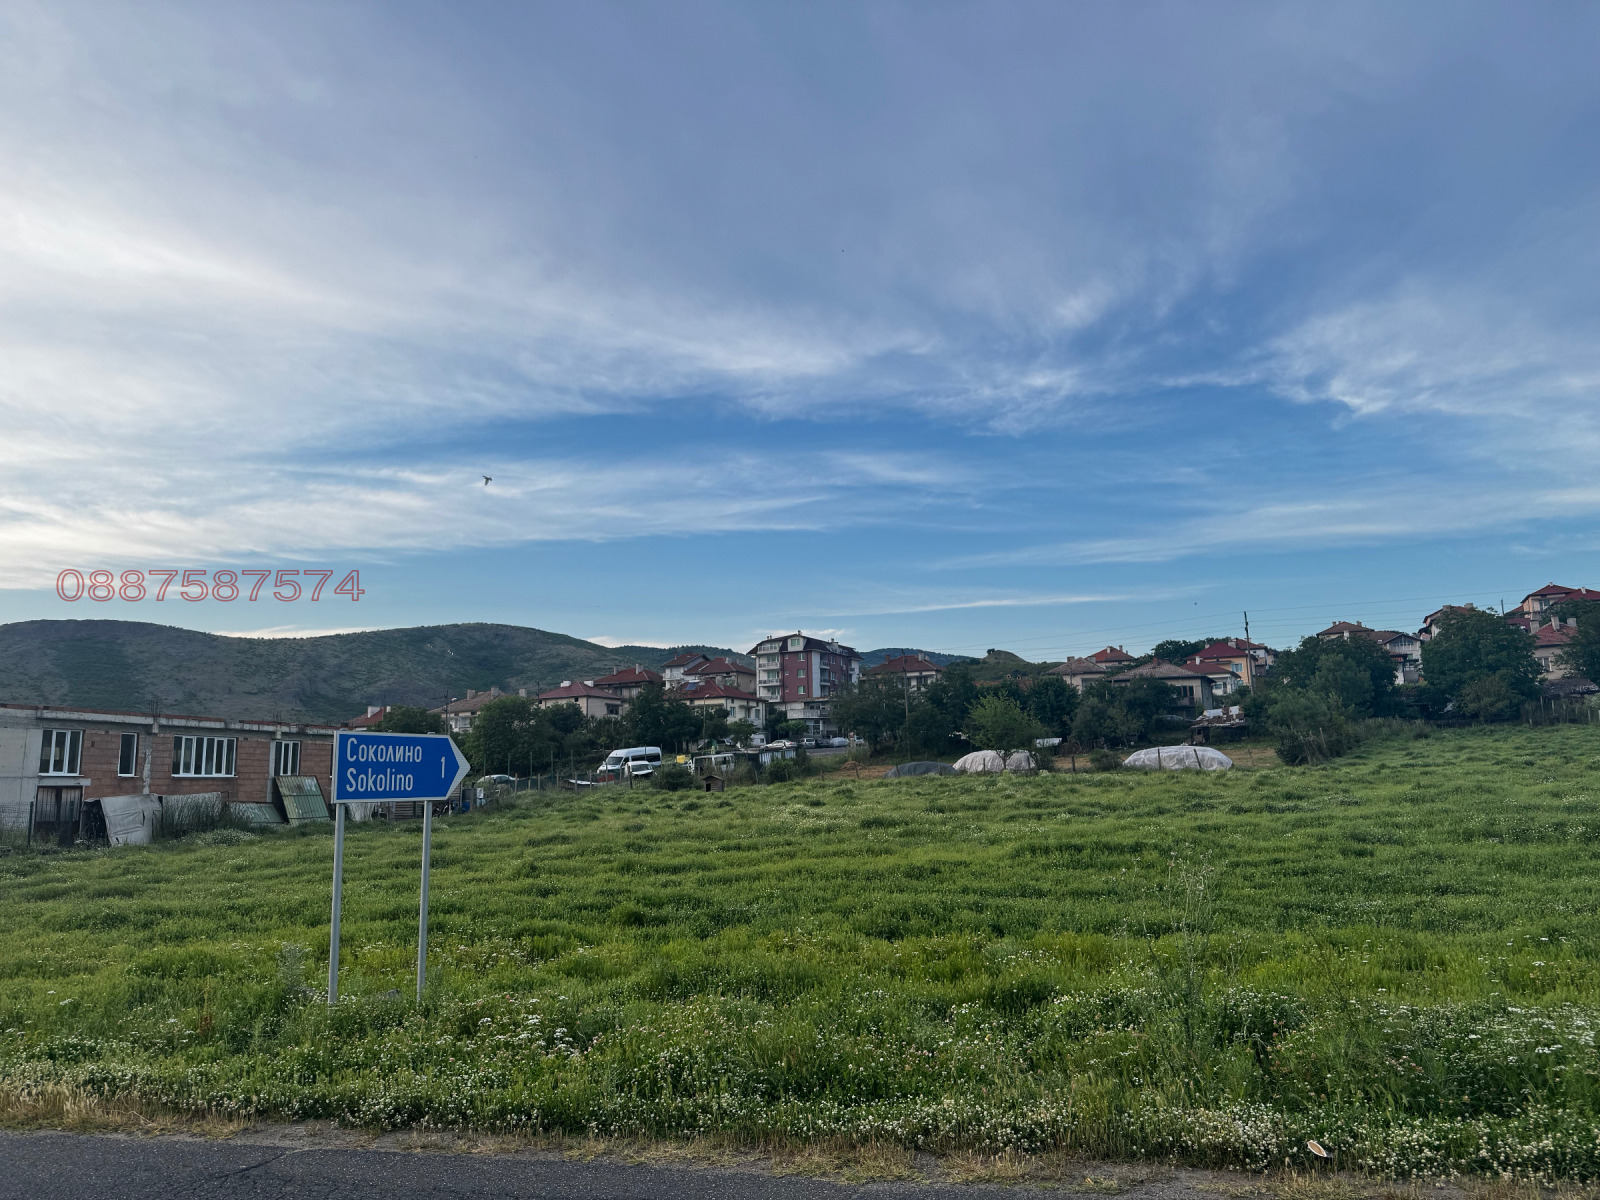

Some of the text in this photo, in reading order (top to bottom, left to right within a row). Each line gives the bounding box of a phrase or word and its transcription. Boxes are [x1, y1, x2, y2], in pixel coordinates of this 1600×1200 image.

[346, 737, 423, 763] Соколино
[345, 767, 414, 792] Sokolino
[440, 756, 446, 779] 1
